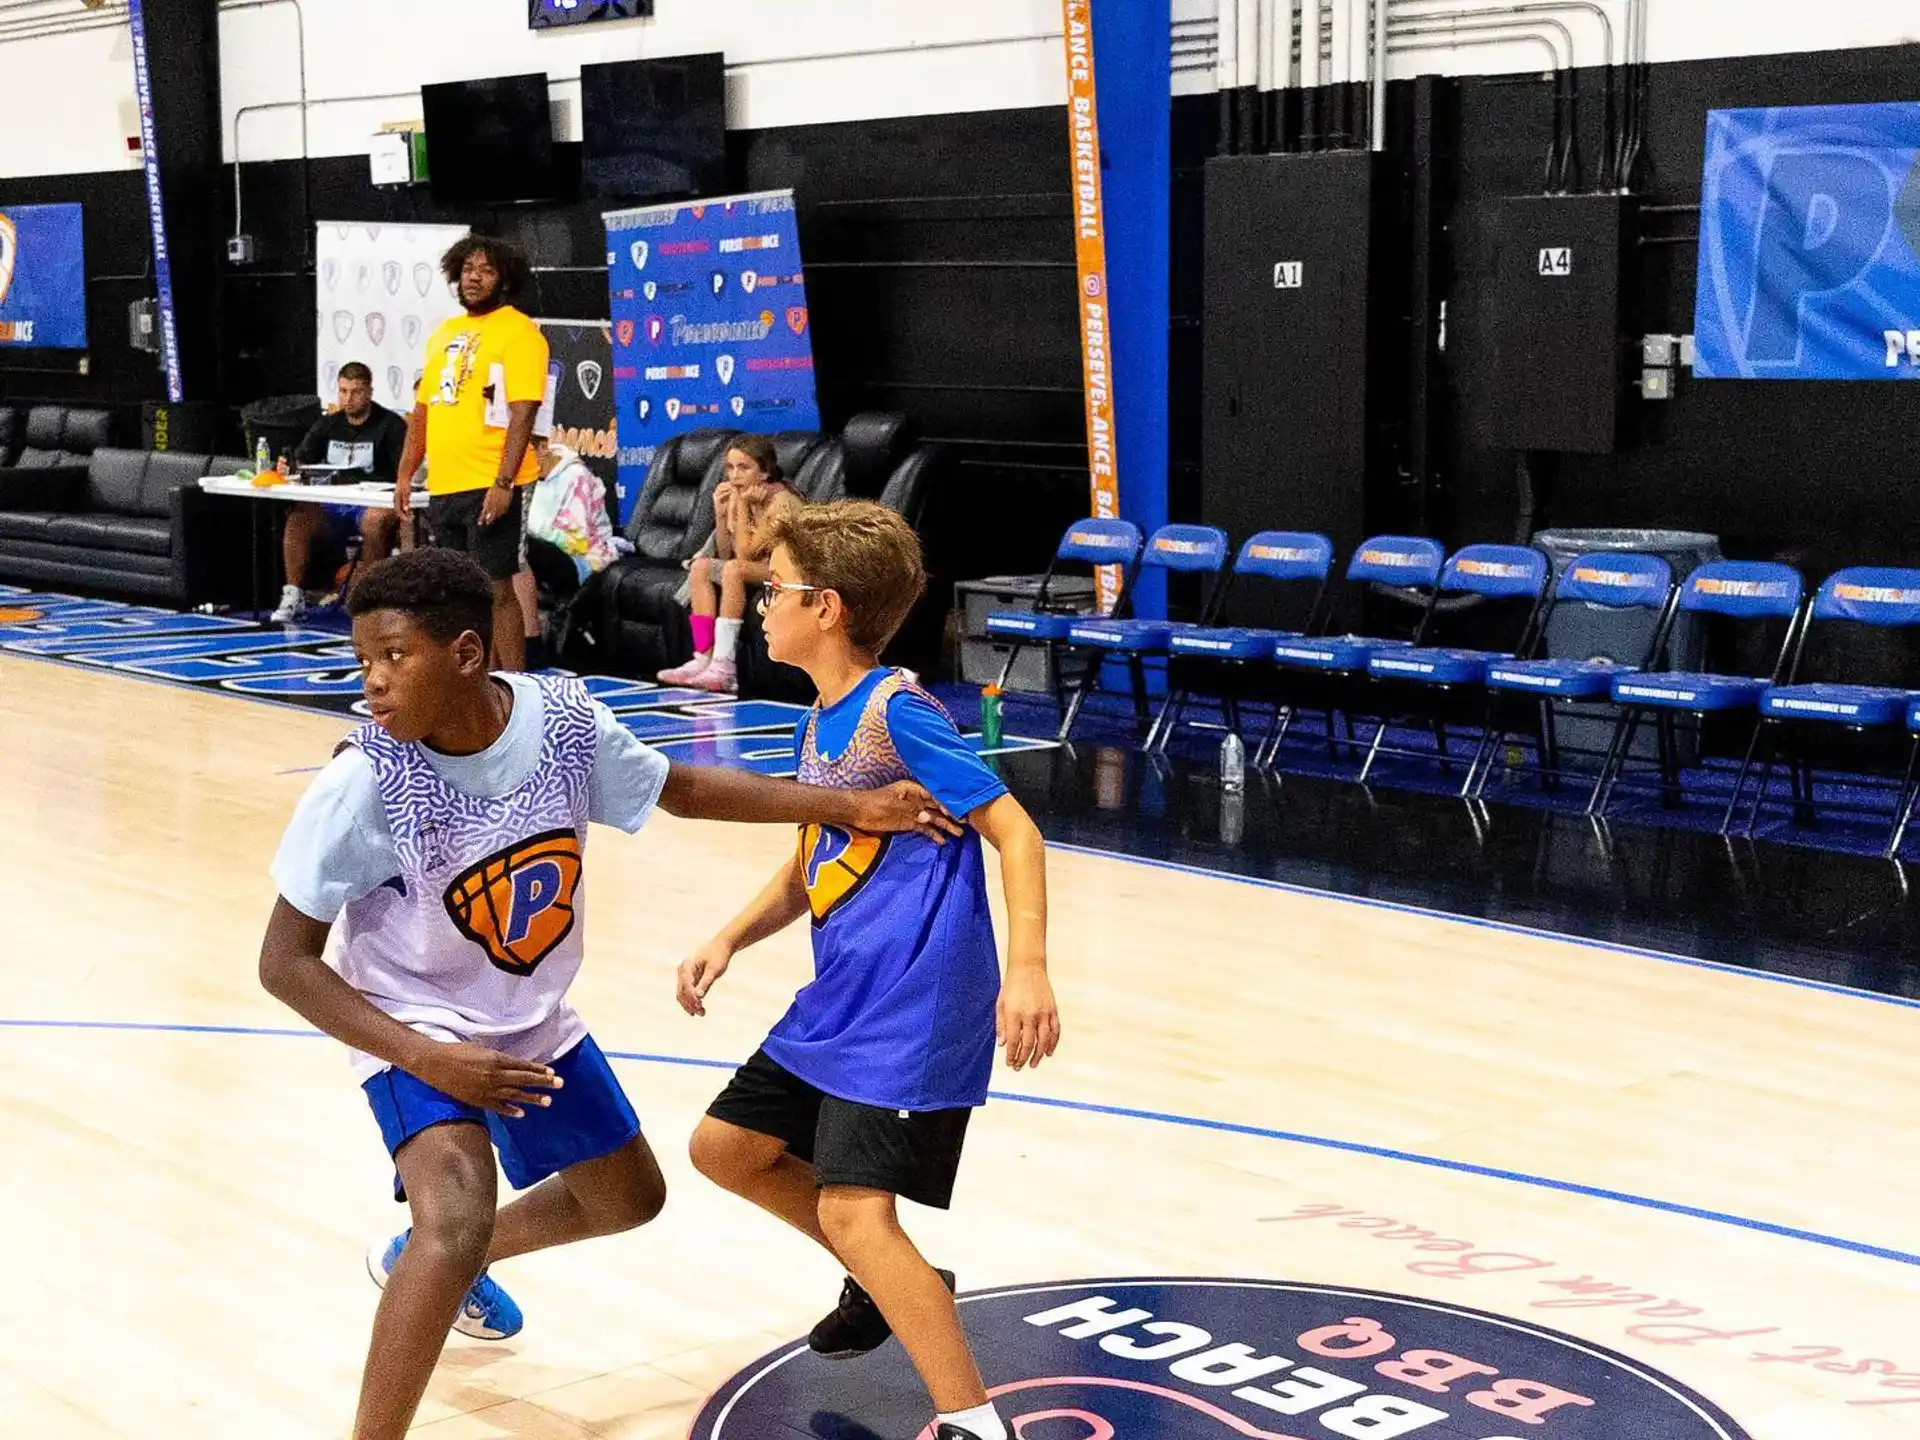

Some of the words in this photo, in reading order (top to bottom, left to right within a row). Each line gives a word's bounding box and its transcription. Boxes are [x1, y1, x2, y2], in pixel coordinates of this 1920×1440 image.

[1275, 265, 1298, 286] A1
[1541, 250, 1569, 273] A4
[504, 860, 563, 947] P
[1257, 1202, 1556, 1281] Beach
[1022, 1296, 1450, 1440] BEACH
[1297, 1316, 1596, 1424] BBQ
